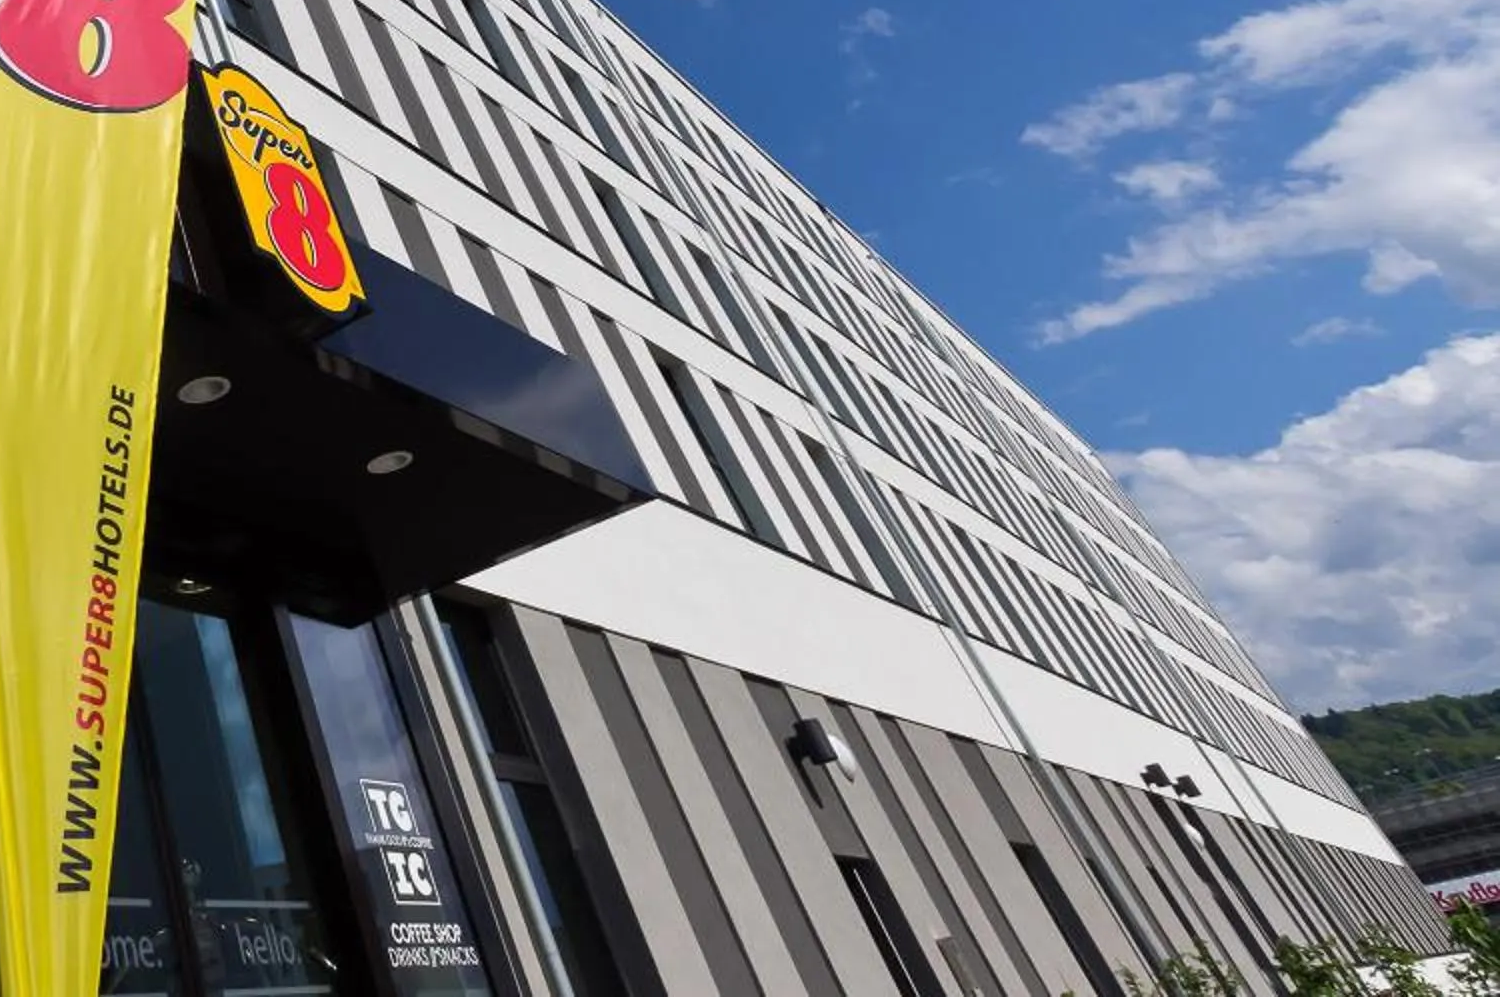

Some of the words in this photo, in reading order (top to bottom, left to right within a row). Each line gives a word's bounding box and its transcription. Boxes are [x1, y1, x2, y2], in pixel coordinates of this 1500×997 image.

[217, 90, 313, 170] Super
[263, 162, 346, 292] 8
[57, 383, 136, 895] WWW.SUPER8HOTELS.DE
[388, 946, 429, 967] DRINKS
[390, 922, 434, 944] COFFEE
[434, 922, 462, 944] SHOP
